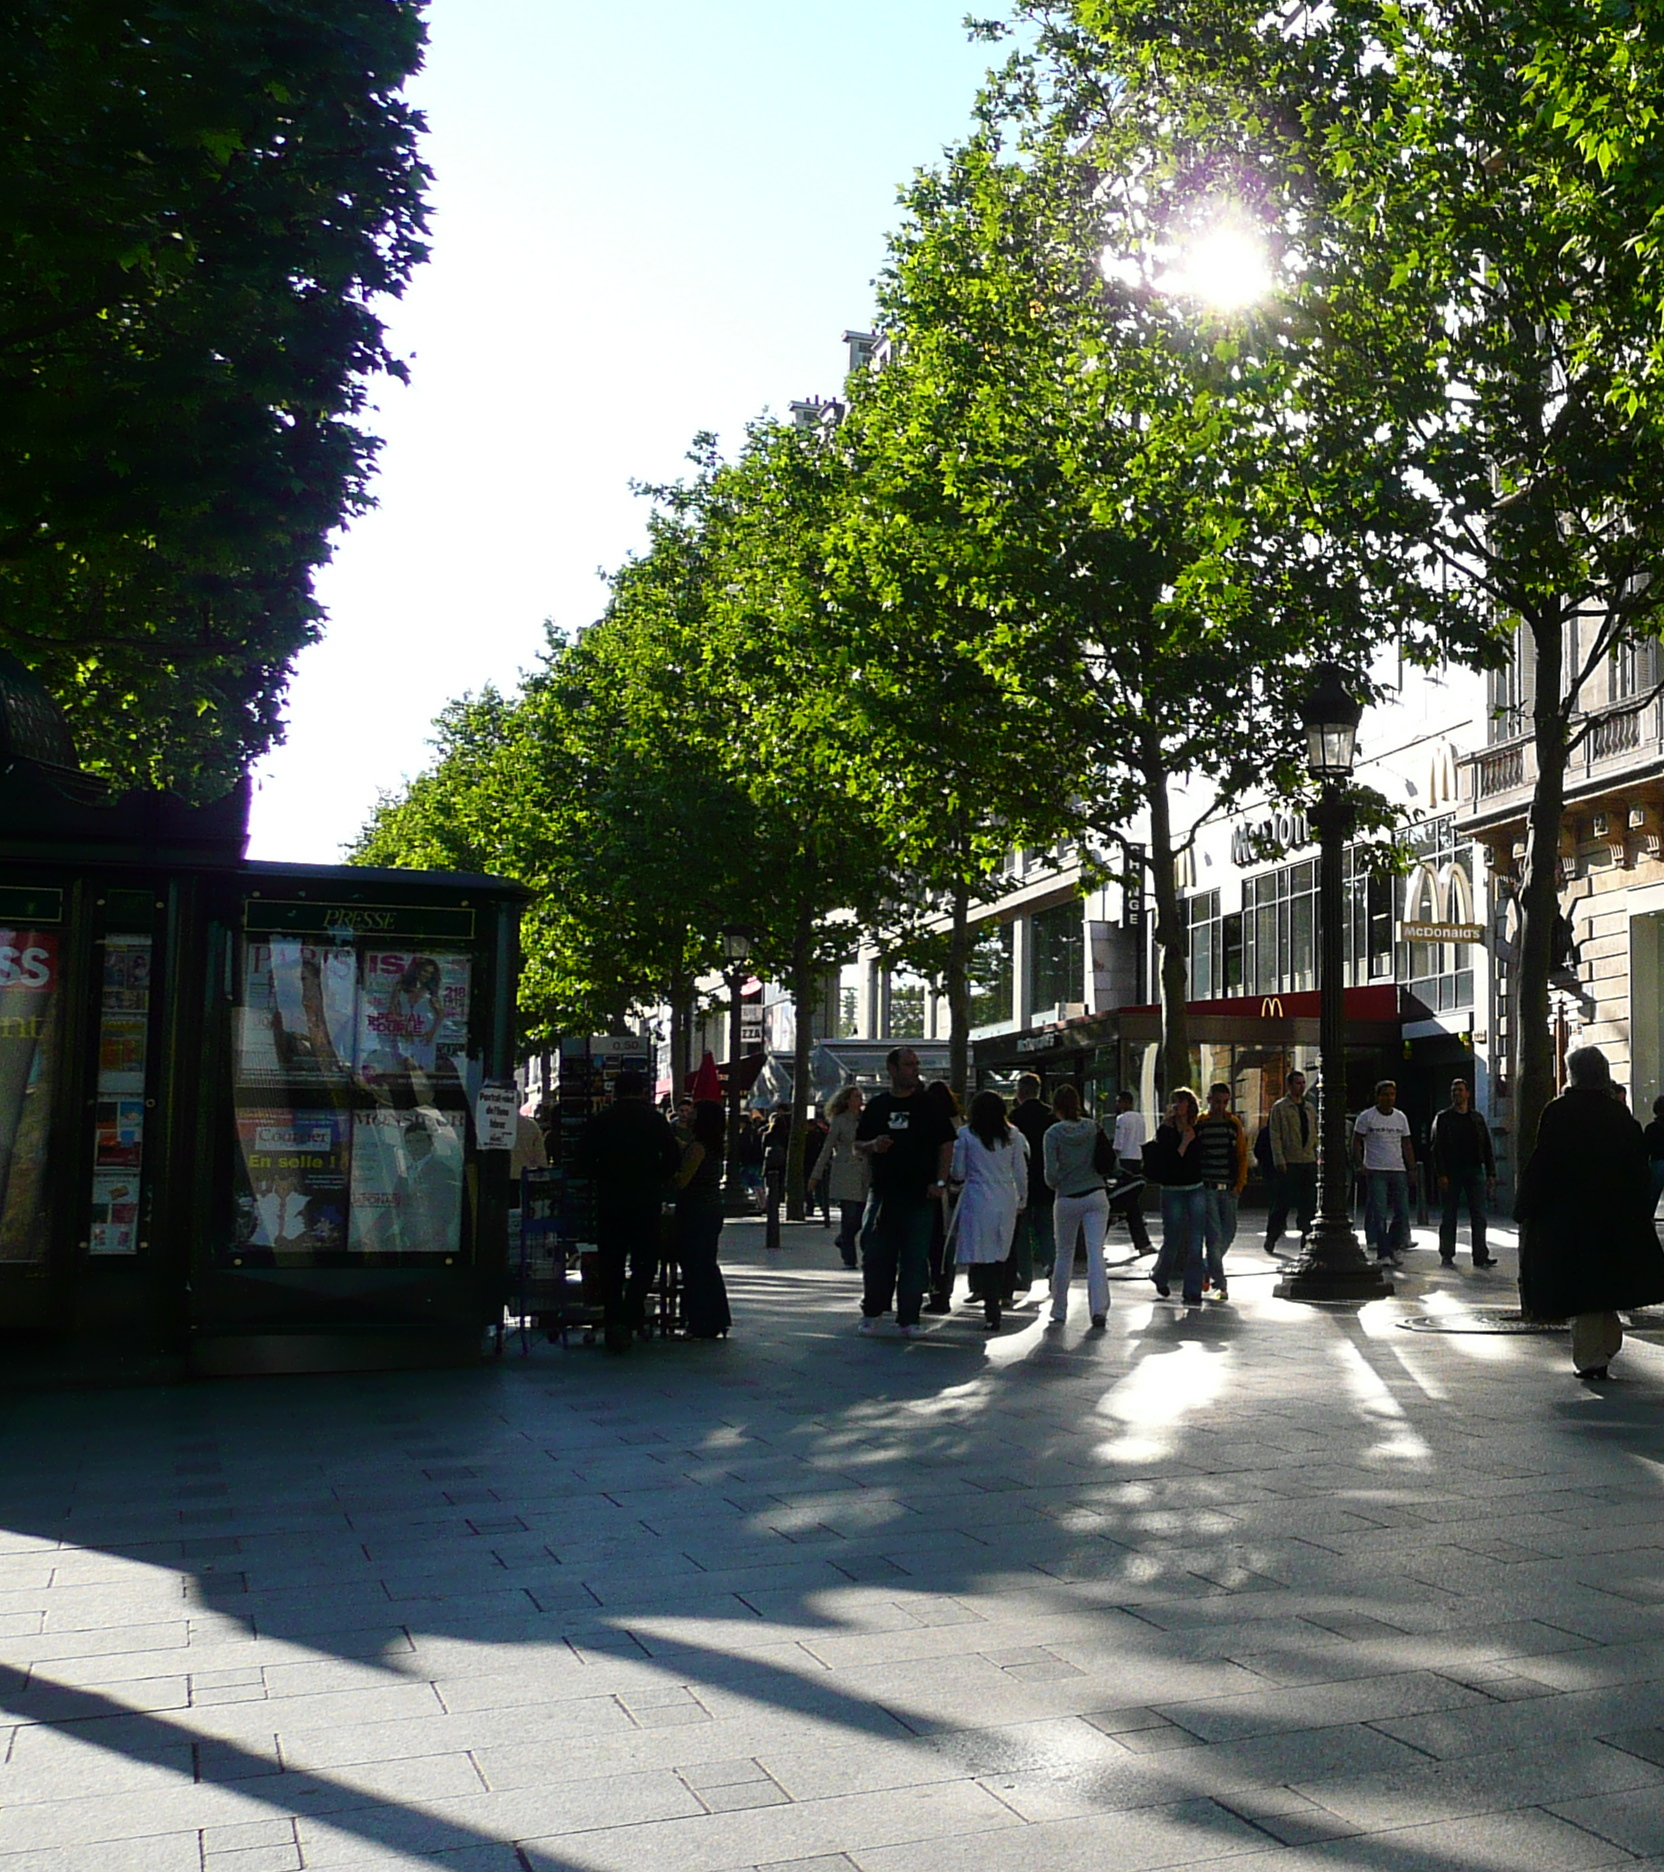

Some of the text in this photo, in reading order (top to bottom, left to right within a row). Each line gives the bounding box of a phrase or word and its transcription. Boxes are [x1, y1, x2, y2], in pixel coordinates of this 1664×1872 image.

[322, 908, 398, 930] PRESSE
[1403, 926, 1481, 940] McDonald's
[249, 1156, 272, 1168] En
[277, 1156, 323, 1169] selle
